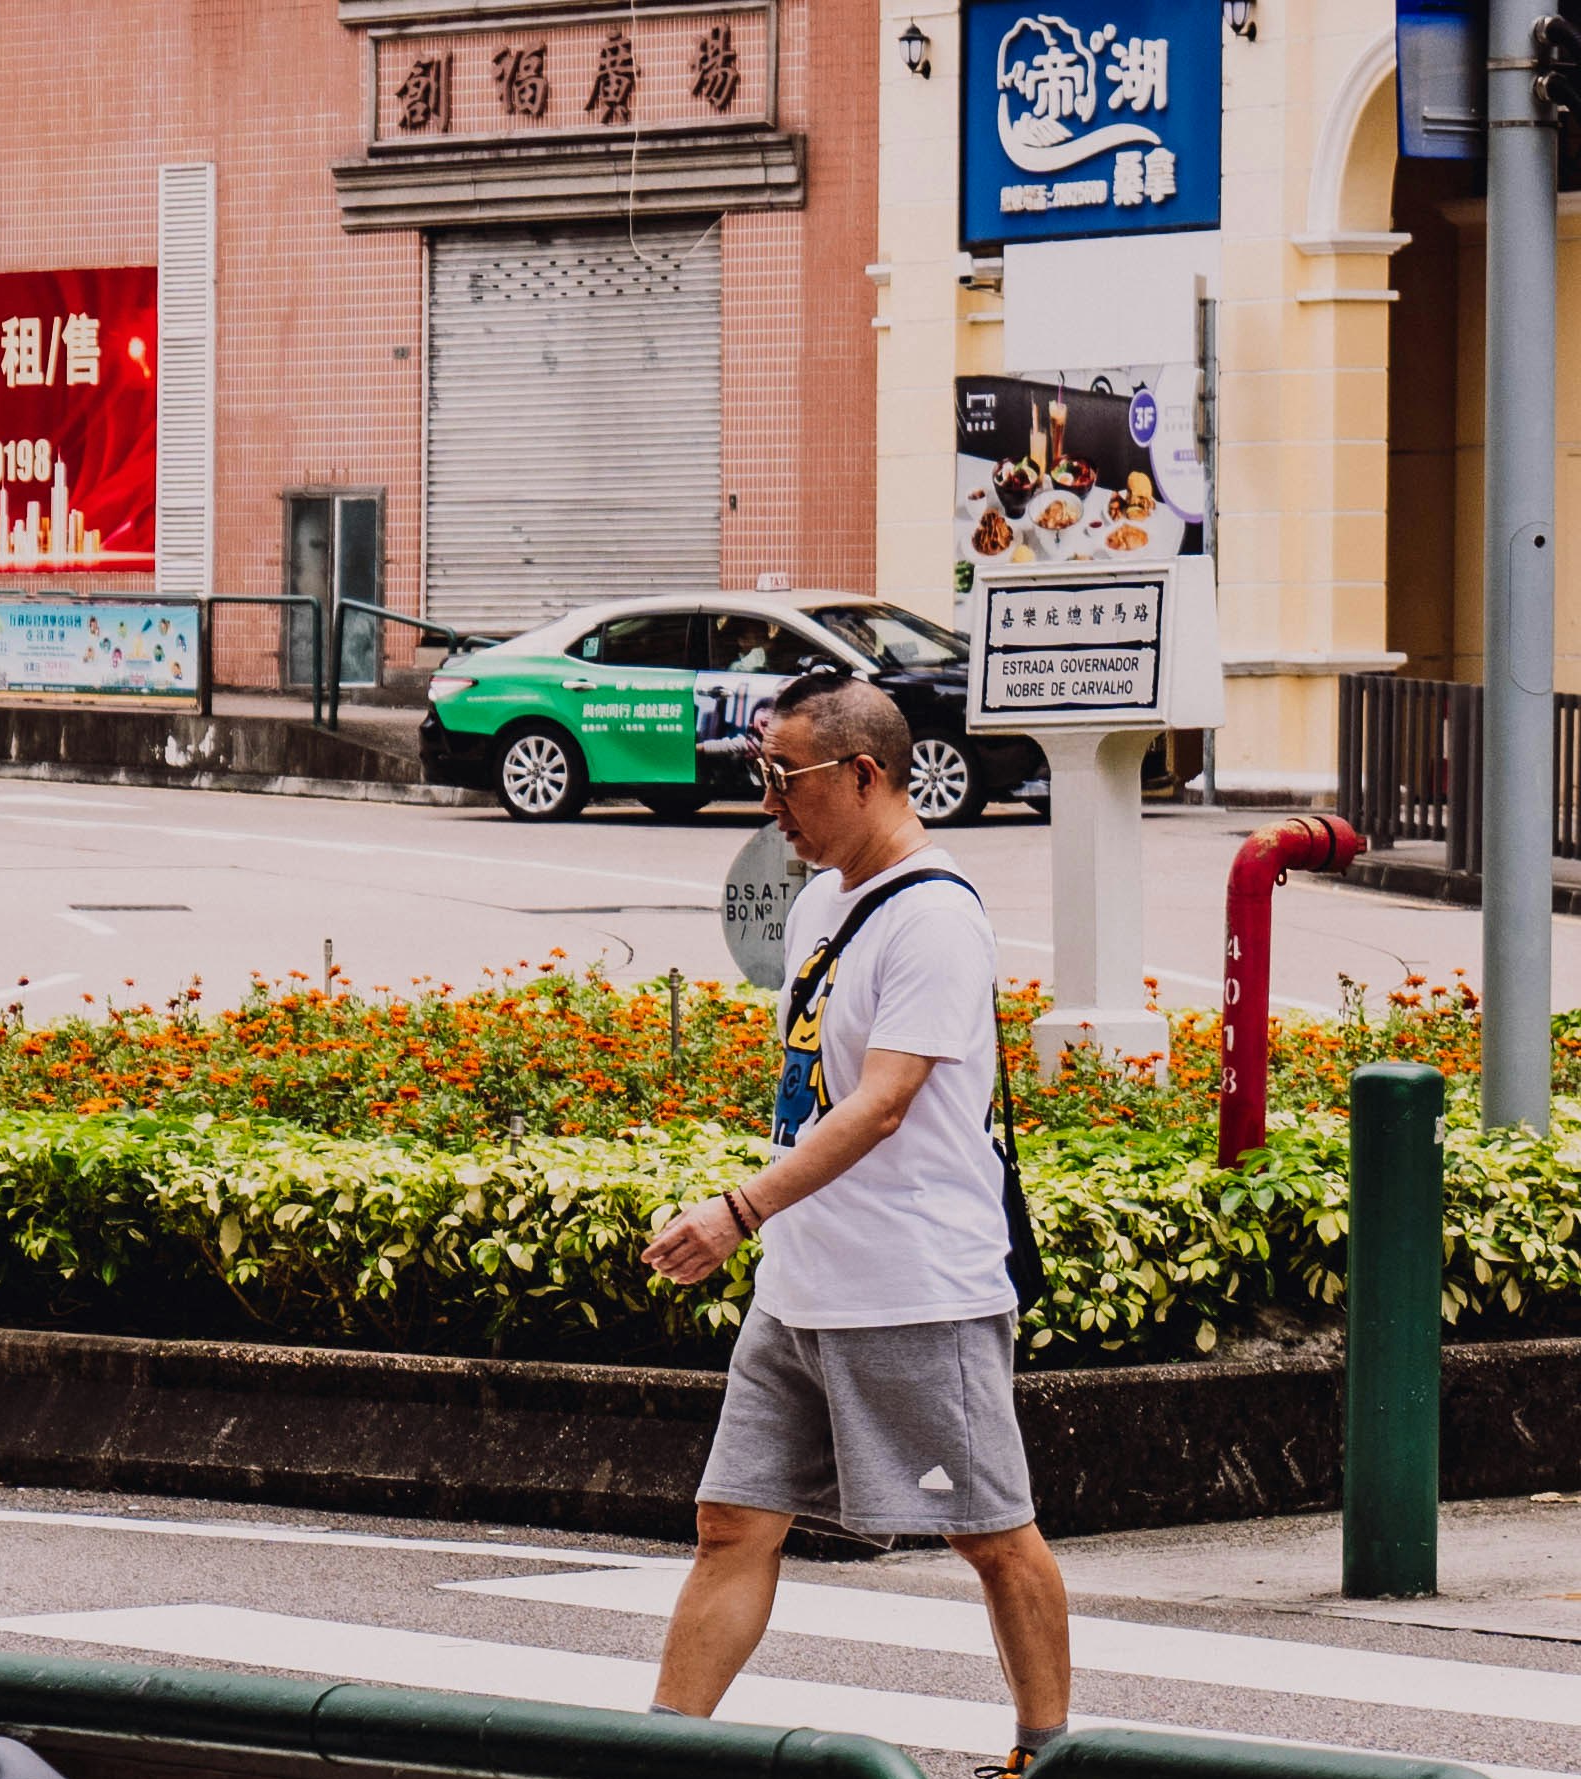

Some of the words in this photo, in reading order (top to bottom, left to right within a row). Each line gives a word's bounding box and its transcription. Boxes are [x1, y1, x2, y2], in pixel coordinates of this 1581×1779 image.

[0, 312, 101, 388] 租/售
[1134, 406, 1155, 430] 3F
[1000, 602, 1149, 630] 嘉樂庇總督馬路
[1002, 659, 1055, 675] ESTRADA
[1060, 656, 1140, 673] GOVERNADOR
[1005, 682, 1045, 698] NOBRE
[1051, 681, 1066, 696] DE
[1071, 679, 1133, 696] CARVALHO
[762, 922, 786, 941] /20
